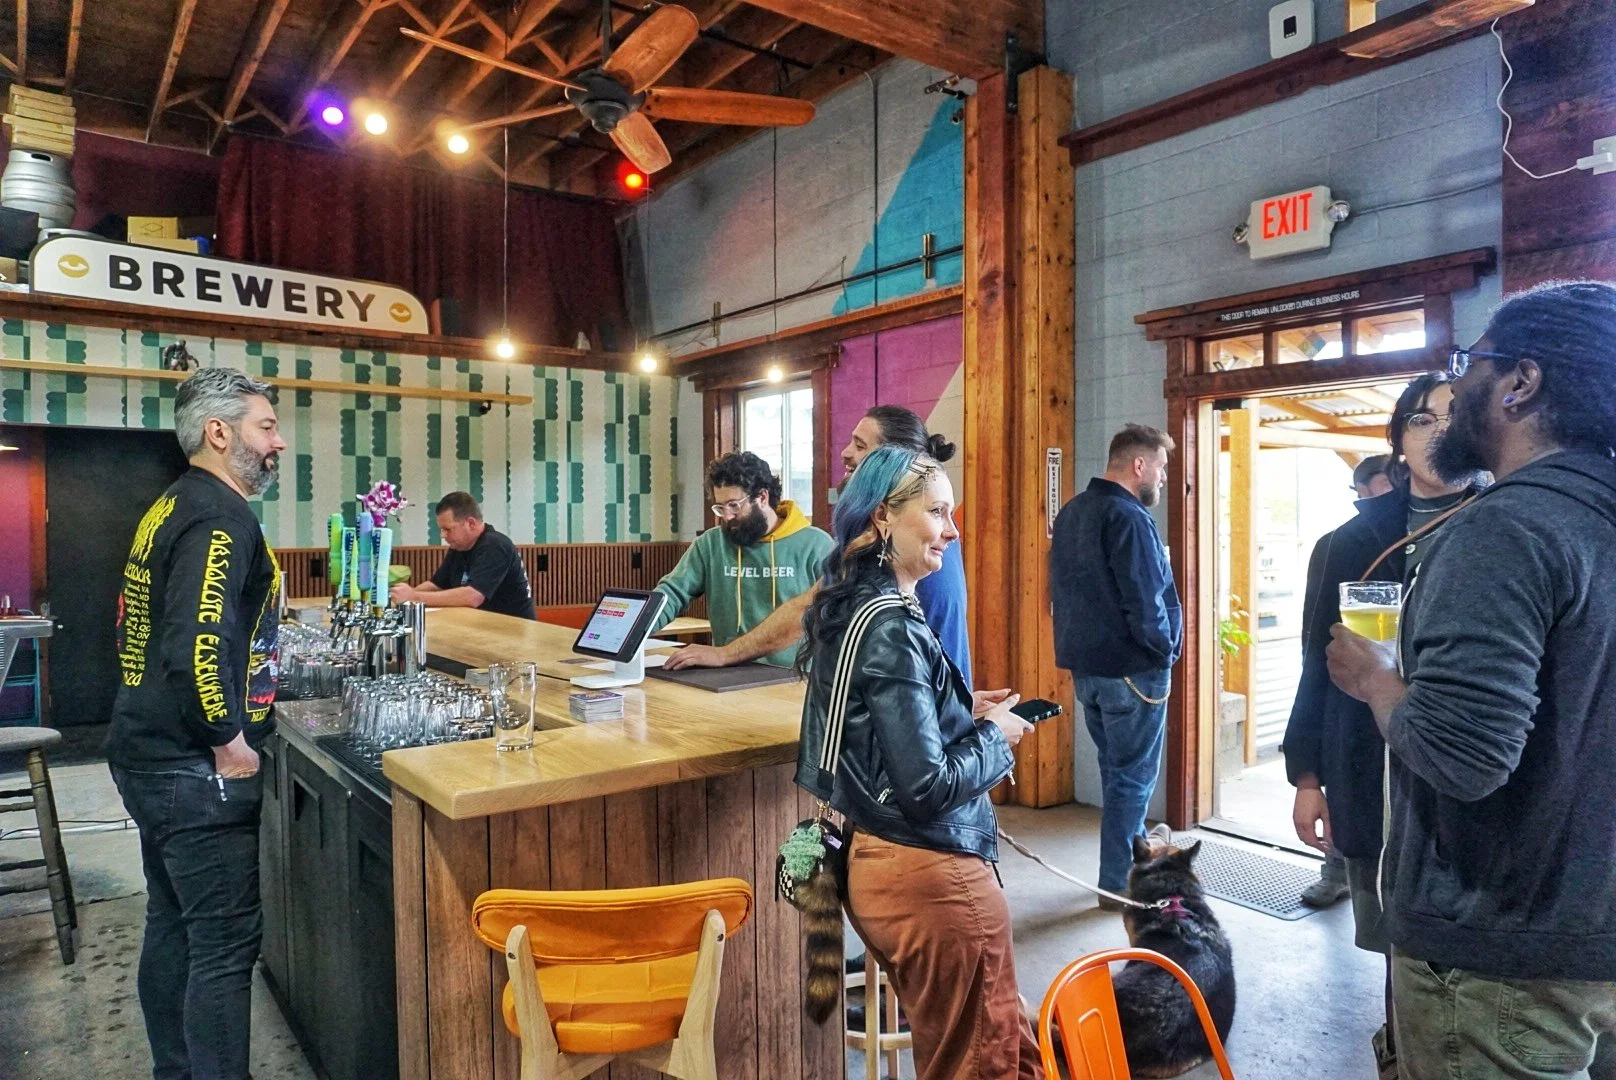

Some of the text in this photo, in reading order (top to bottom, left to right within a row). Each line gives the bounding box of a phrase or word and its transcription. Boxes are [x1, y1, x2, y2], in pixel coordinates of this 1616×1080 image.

[1263, 192, 1313, 239] EXIT
[109, 254, 376, 322] BREWERY
[1221, 290, 1360, 321] THIS DOOR TO REMAIN UNLOCKED DURING BUSINESS HOURS
[1049, 457, 1059, 465] FIRE
[724, 566, 794, 578] LEVEL BEER
[136, 632, 150, 640] ON
[139, 624, 151, 632] QC
[194, 530, 233, 723] ABSOLUTE ELSEWHERE
